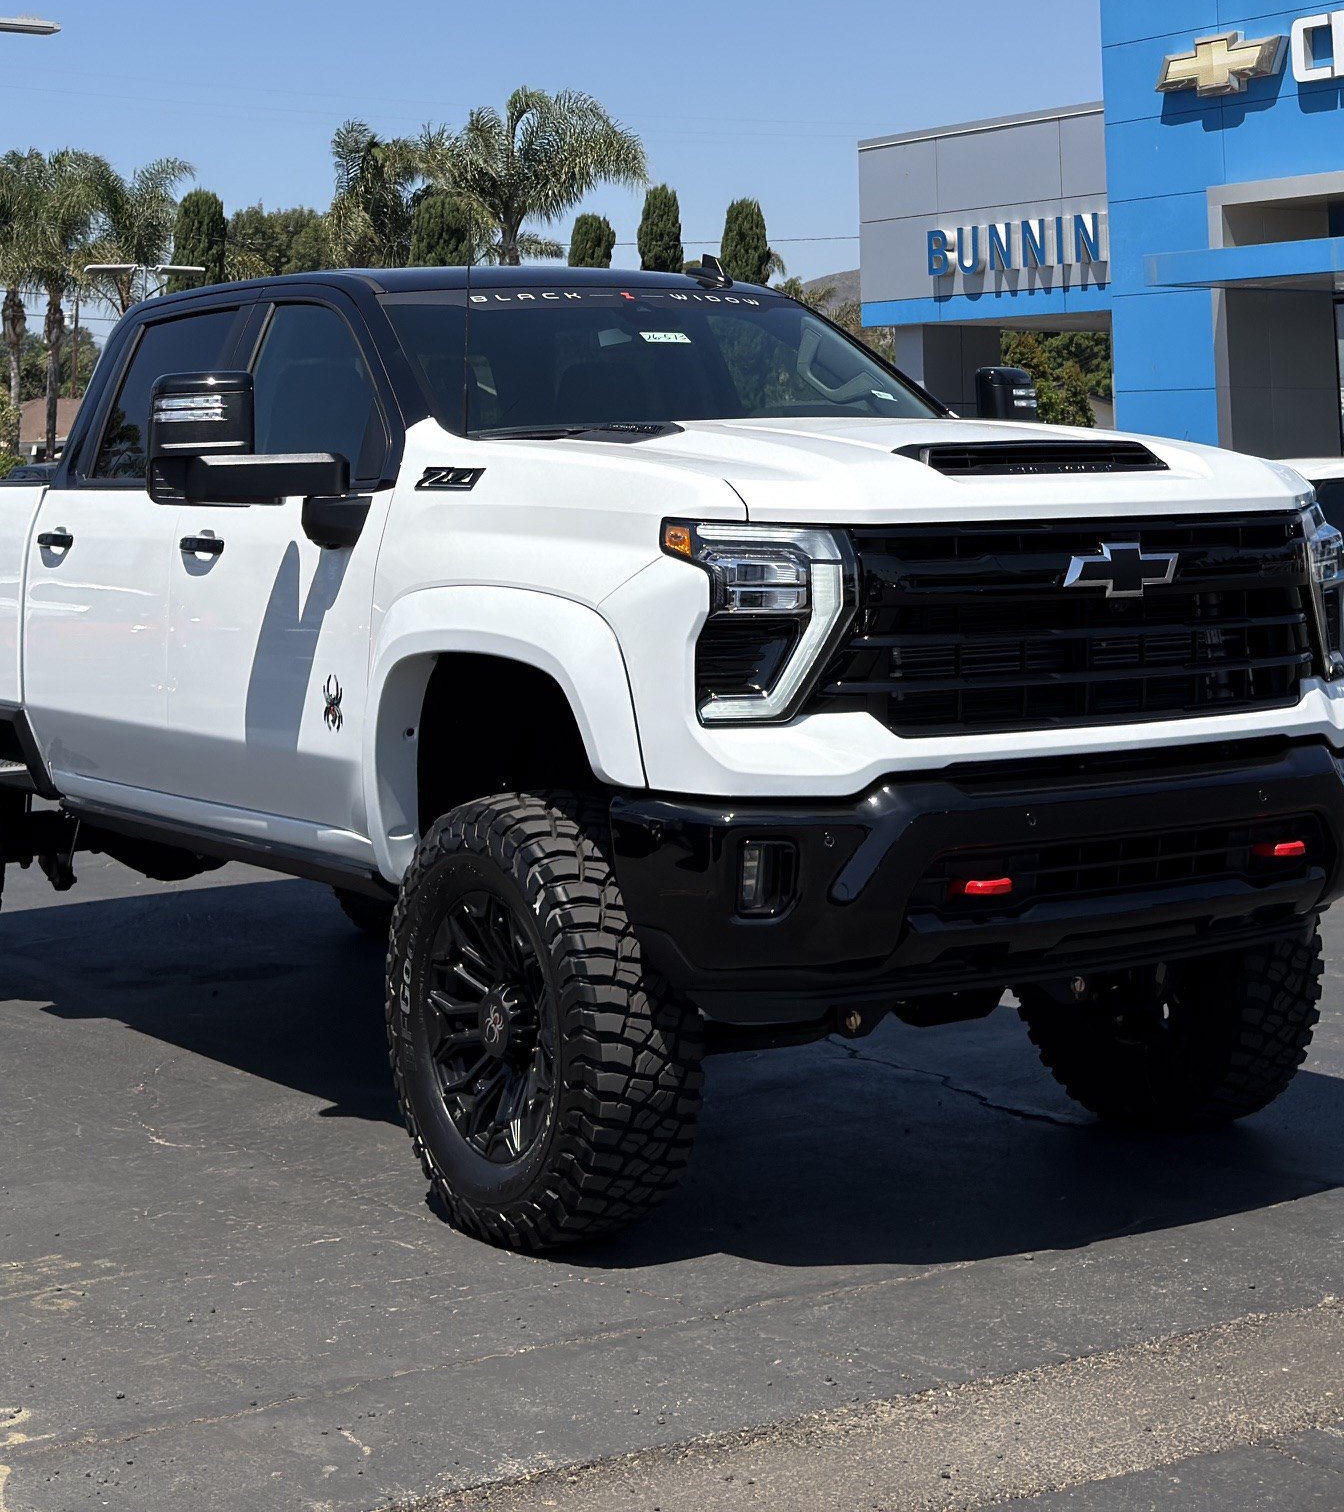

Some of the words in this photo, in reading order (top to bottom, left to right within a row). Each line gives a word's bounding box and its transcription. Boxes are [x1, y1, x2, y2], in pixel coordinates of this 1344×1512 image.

[927, 212, 1108, 276] BUNNIN
[470, 291, 582, 304] BLACK
[669, 292, 760, 306] WIDOW
